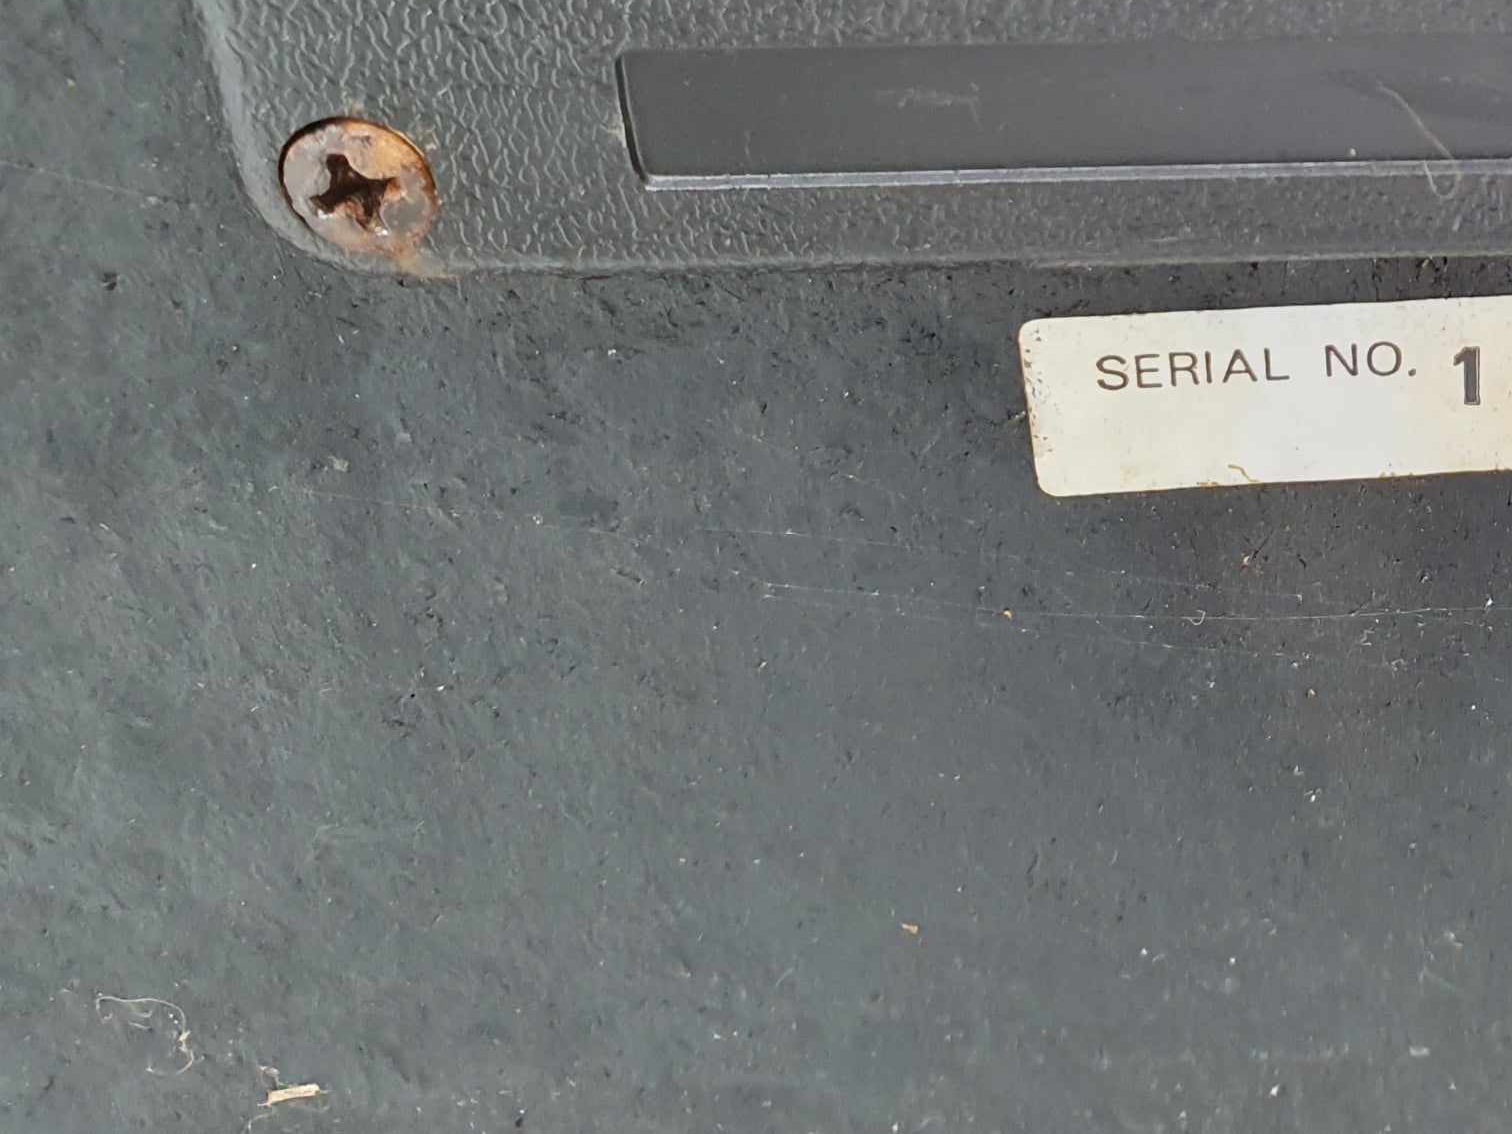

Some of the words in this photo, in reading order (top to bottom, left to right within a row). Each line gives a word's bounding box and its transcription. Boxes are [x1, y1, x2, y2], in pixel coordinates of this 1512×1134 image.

[1096, 348, 1291, 391] SERIAL
[1324, 341, 1417, 378] NO.
[1453, 346, 1481, 406] 1
